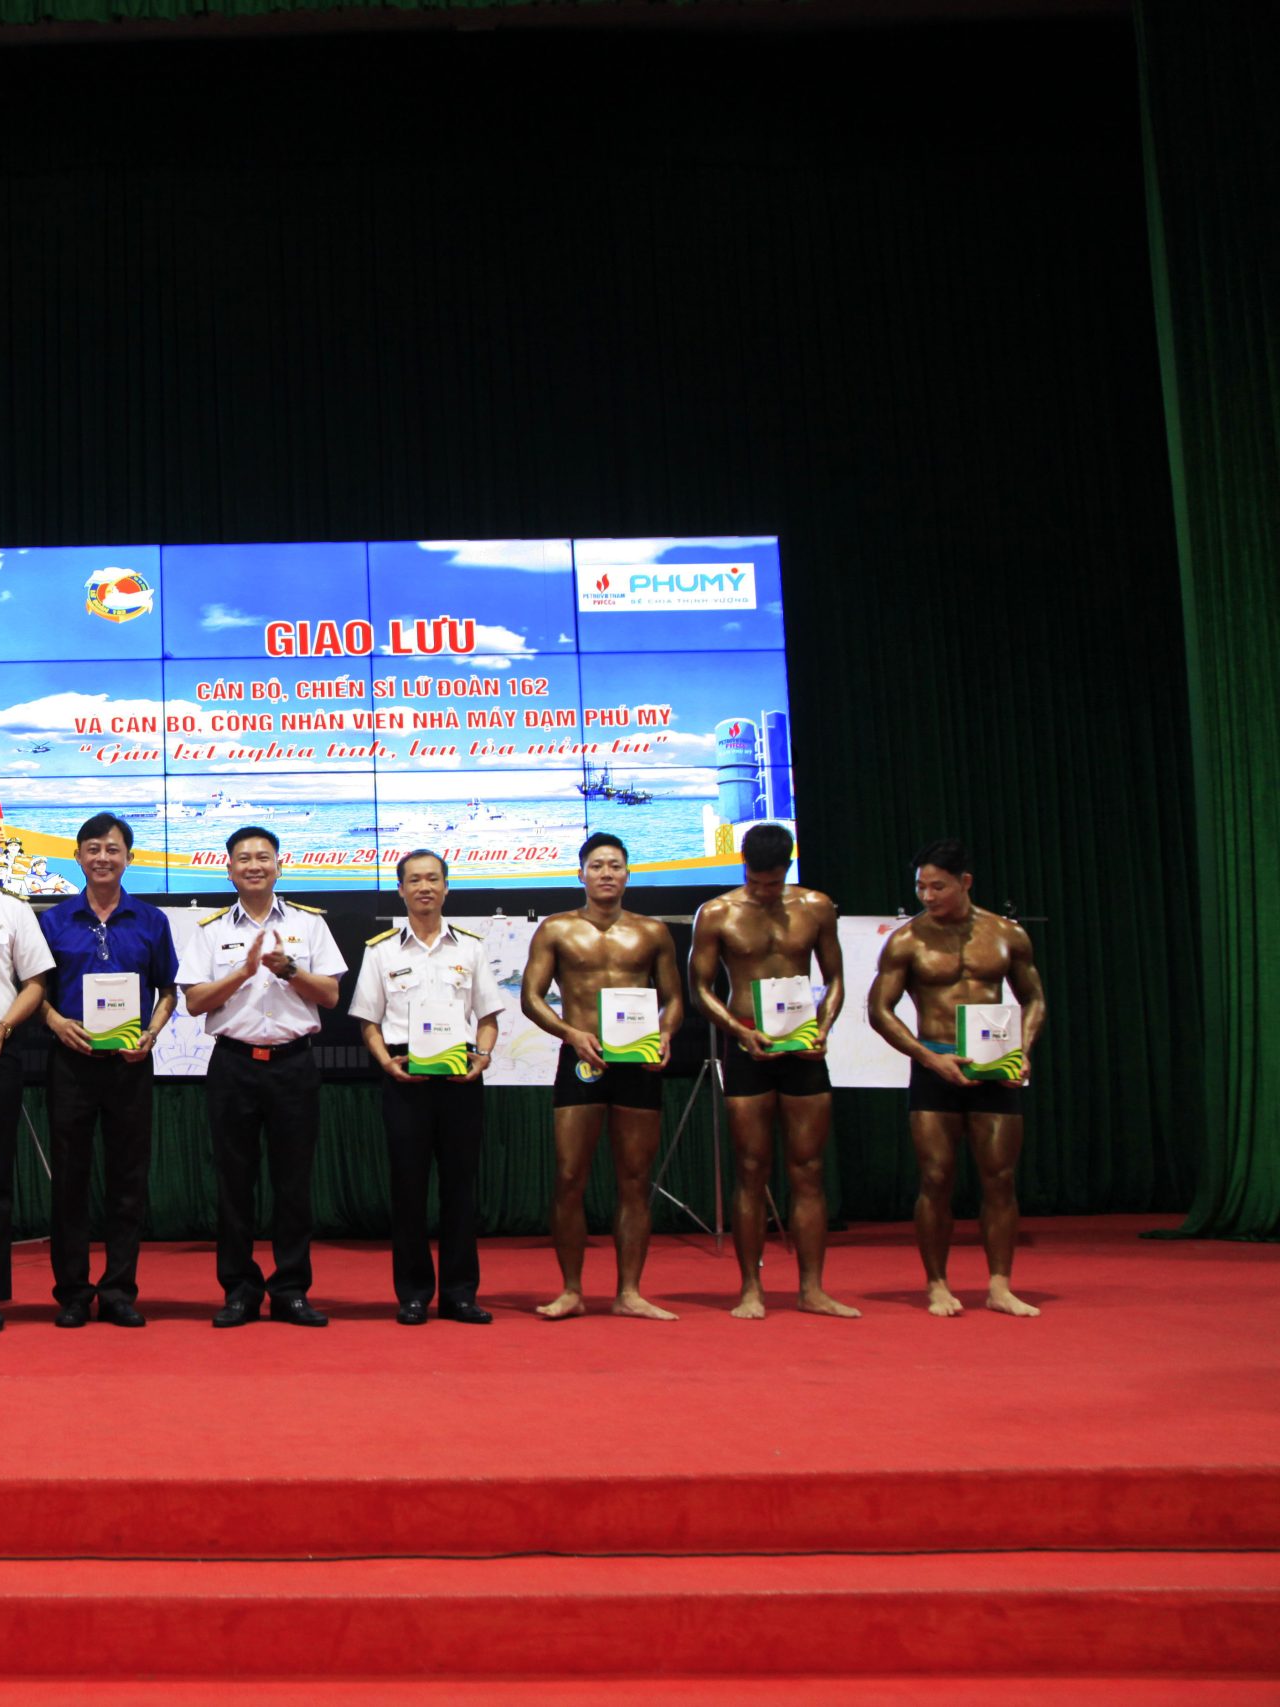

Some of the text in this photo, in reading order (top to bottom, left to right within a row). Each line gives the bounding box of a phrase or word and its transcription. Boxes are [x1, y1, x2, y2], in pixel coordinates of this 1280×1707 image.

[267, 617, 476, 656] GIAO LƯU
[197, 675, 548, 704] CÁN BỘ, CHIẾN SĨ LỮ ĐOÀN 162
[211, 711, 272, 732] CÔNG
[281, 710, 344, 731] NHÂN
[413, 708, 459, 729] NHÀ
[467, 707, 516, 728] MÁY
[525, 709, 577, 731] ĐẠM
[585, 704, 629, 726] PHÚ
[637, 704, 671, 726] MỸ
[409, 740, 457, 756] lan
[351, 848, 377, 863] 29
[513, 846, 559, 861] 2024
